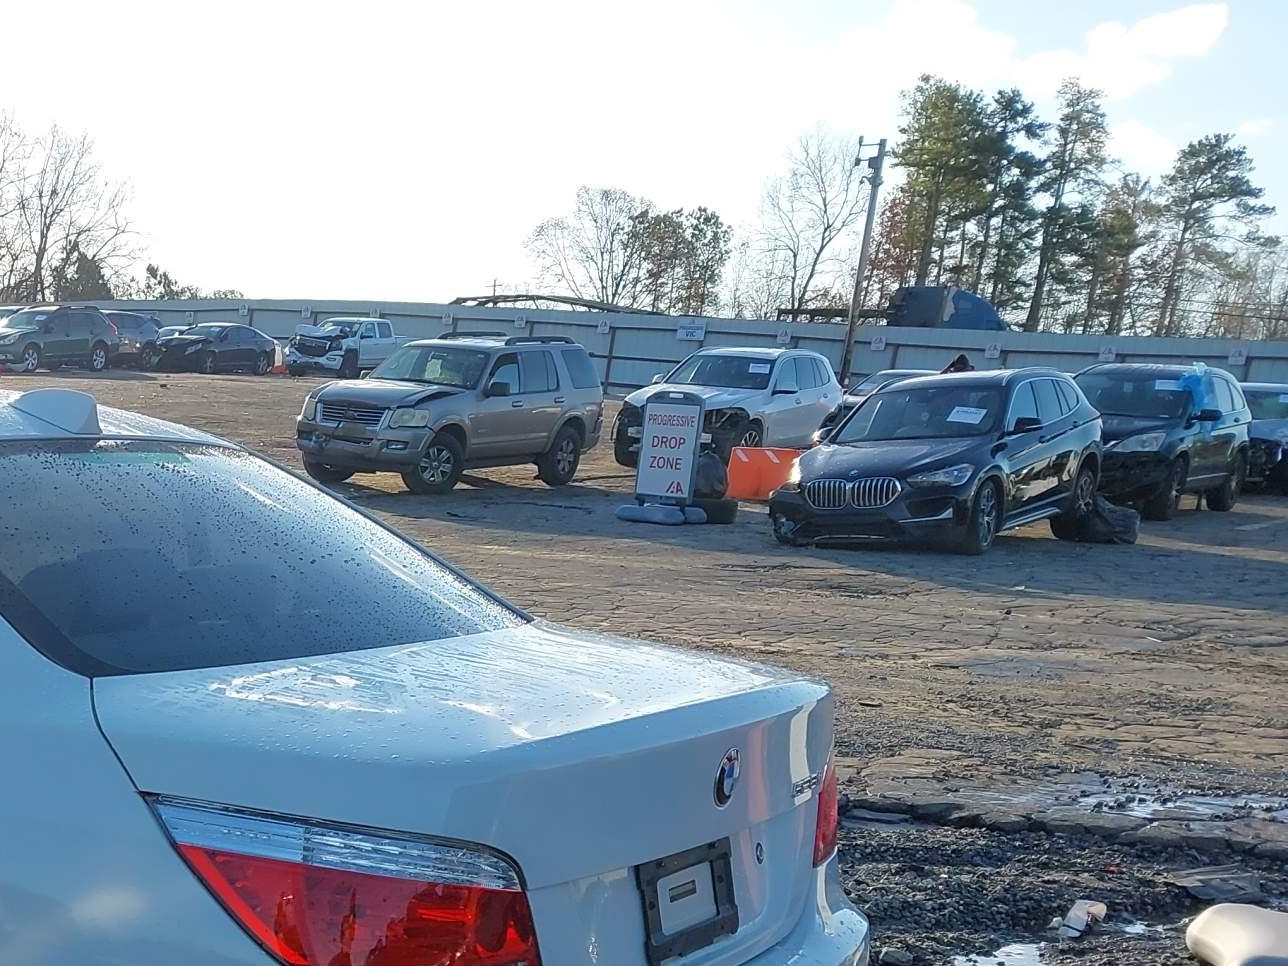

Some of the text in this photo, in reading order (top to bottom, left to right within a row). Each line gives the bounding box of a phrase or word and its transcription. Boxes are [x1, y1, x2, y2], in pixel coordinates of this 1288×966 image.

[648, 413, 696, 428] PROGRESSIVE
[651, 435, 686, 449] DROP
[648, 455, 683, 470] ZONE
